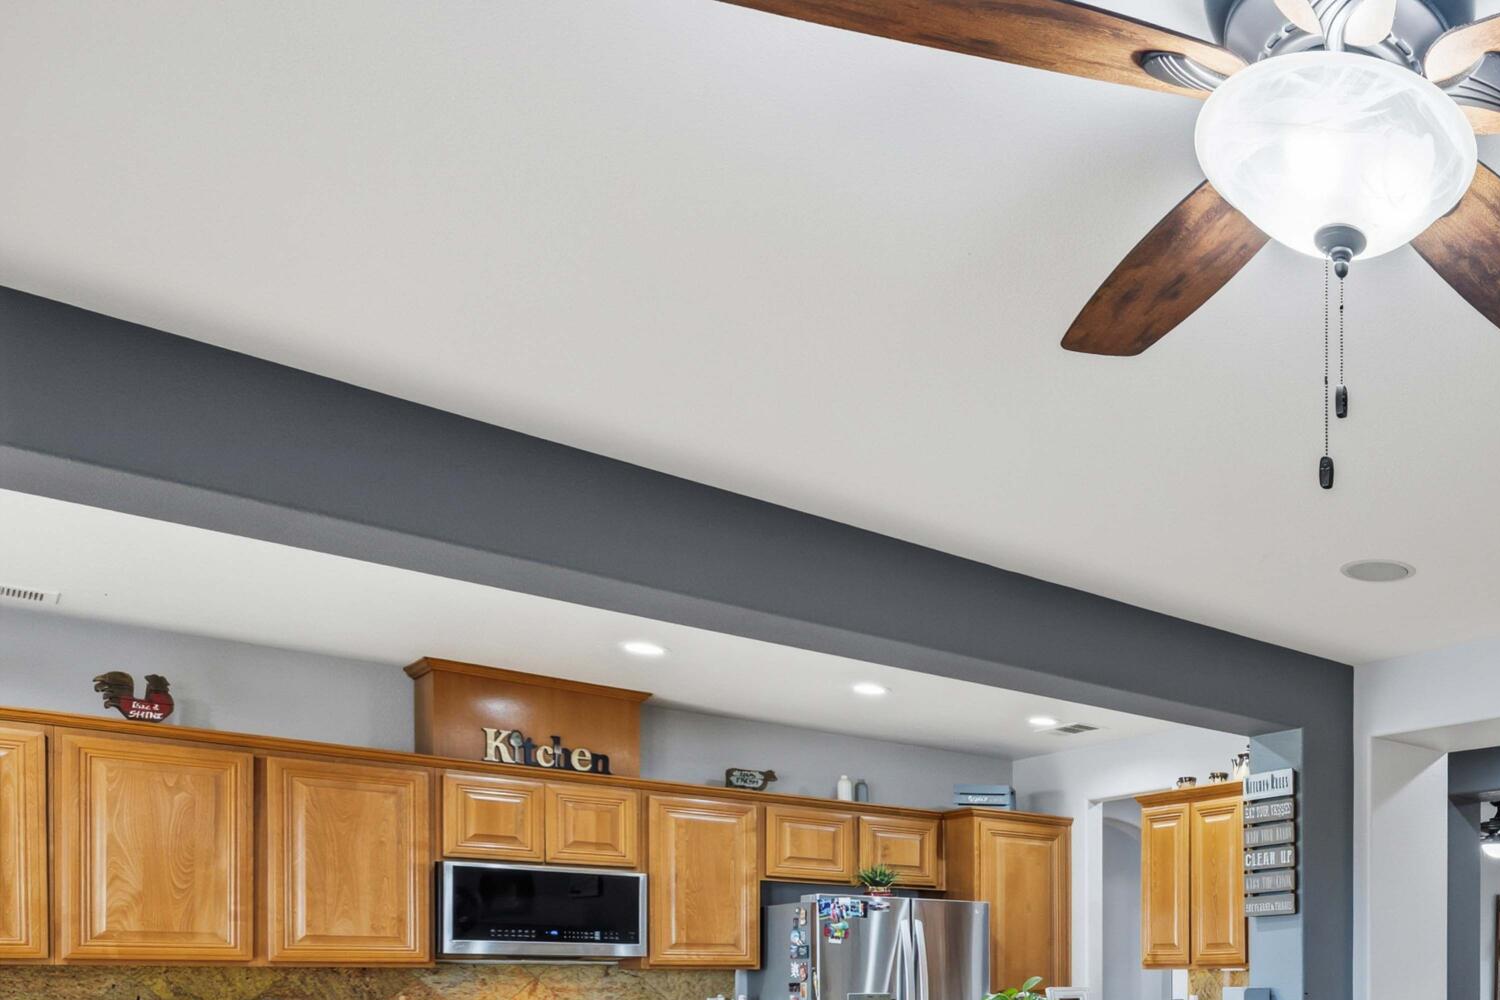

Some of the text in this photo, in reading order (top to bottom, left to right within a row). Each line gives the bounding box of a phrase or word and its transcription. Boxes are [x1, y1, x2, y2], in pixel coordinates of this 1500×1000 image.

[481, 727, 613, 775] Kitchen
[1245, 849, 1292, 867] CLEAN UP
